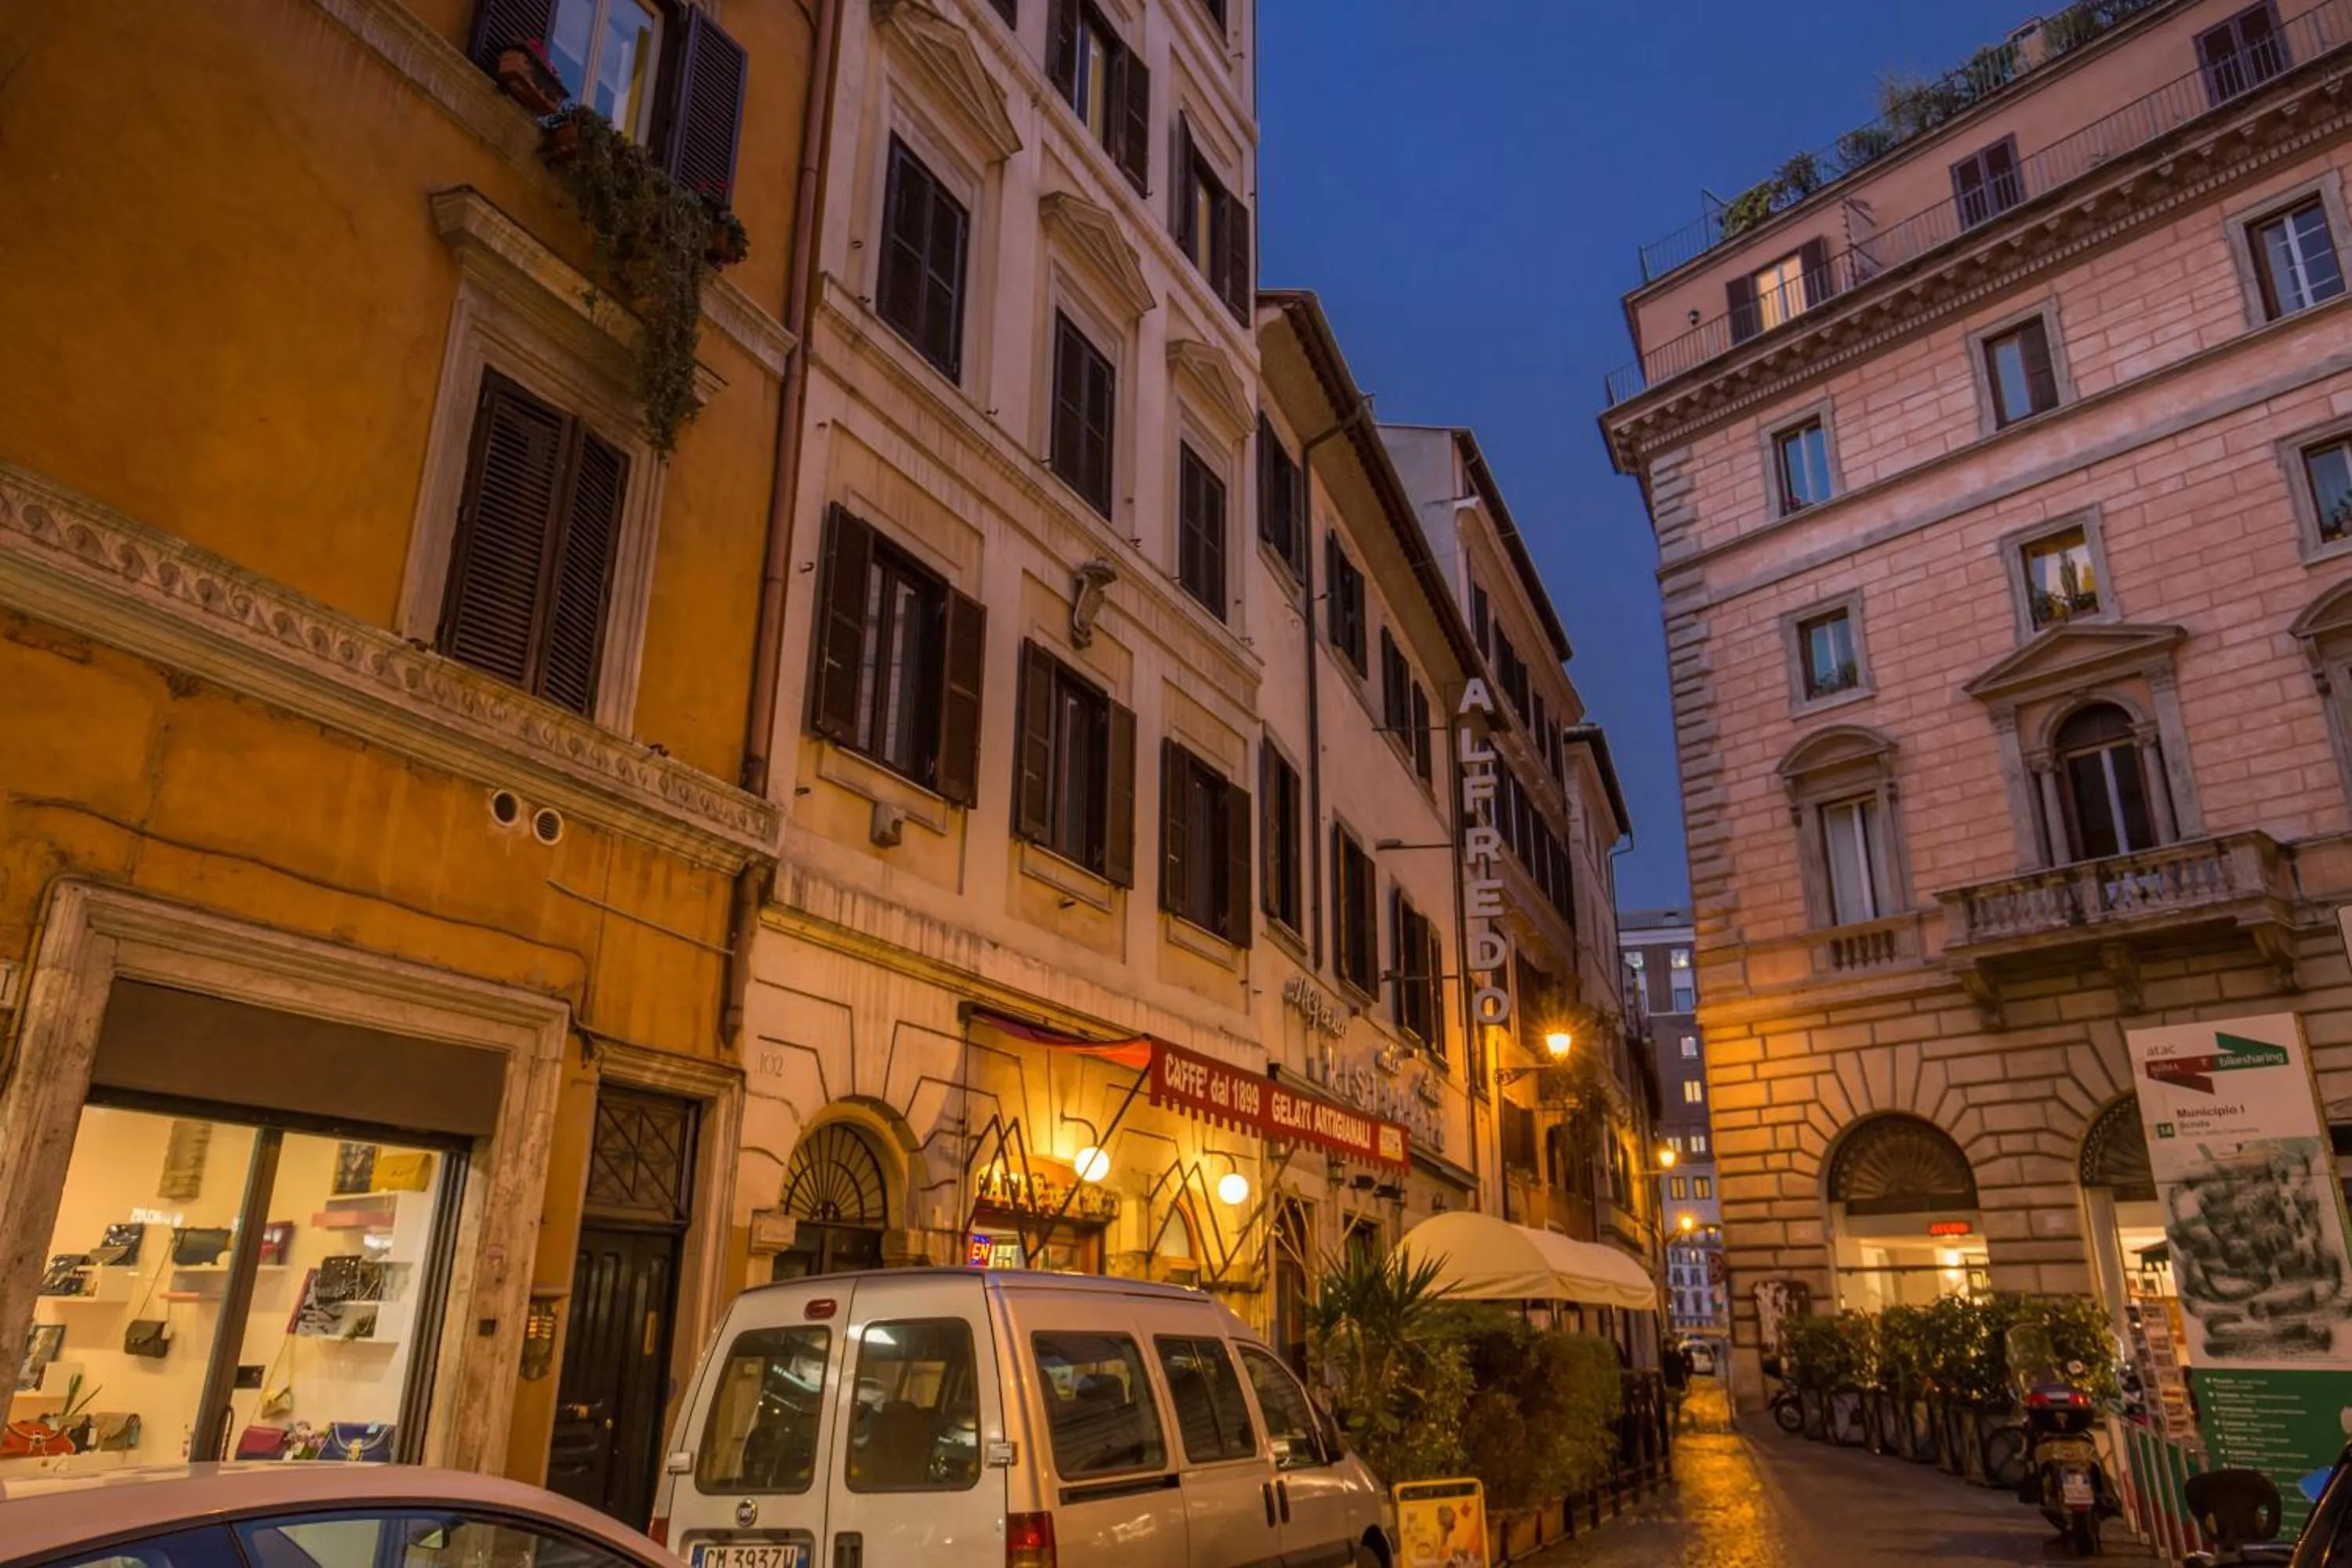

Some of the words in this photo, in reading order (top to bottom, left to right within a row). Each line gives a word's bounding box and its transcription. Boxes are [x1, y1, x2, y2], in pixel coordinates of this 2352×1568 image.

[1458, 677, 1509, 1024] ALFREDO
[2147, 1044, 2176, 1057] atac
[2220, 1052, 2285, 1067] bikesharing
[1165, 1054, 1208, 1098] CAFFE'
[1211, 1072, 1229, 1104] dal
[1232, 1079, 1260, 1116] 1899
[1271, 1091, 1312, 1131] GELATI
[2176, 1105, 2238, 1119] Municipio
